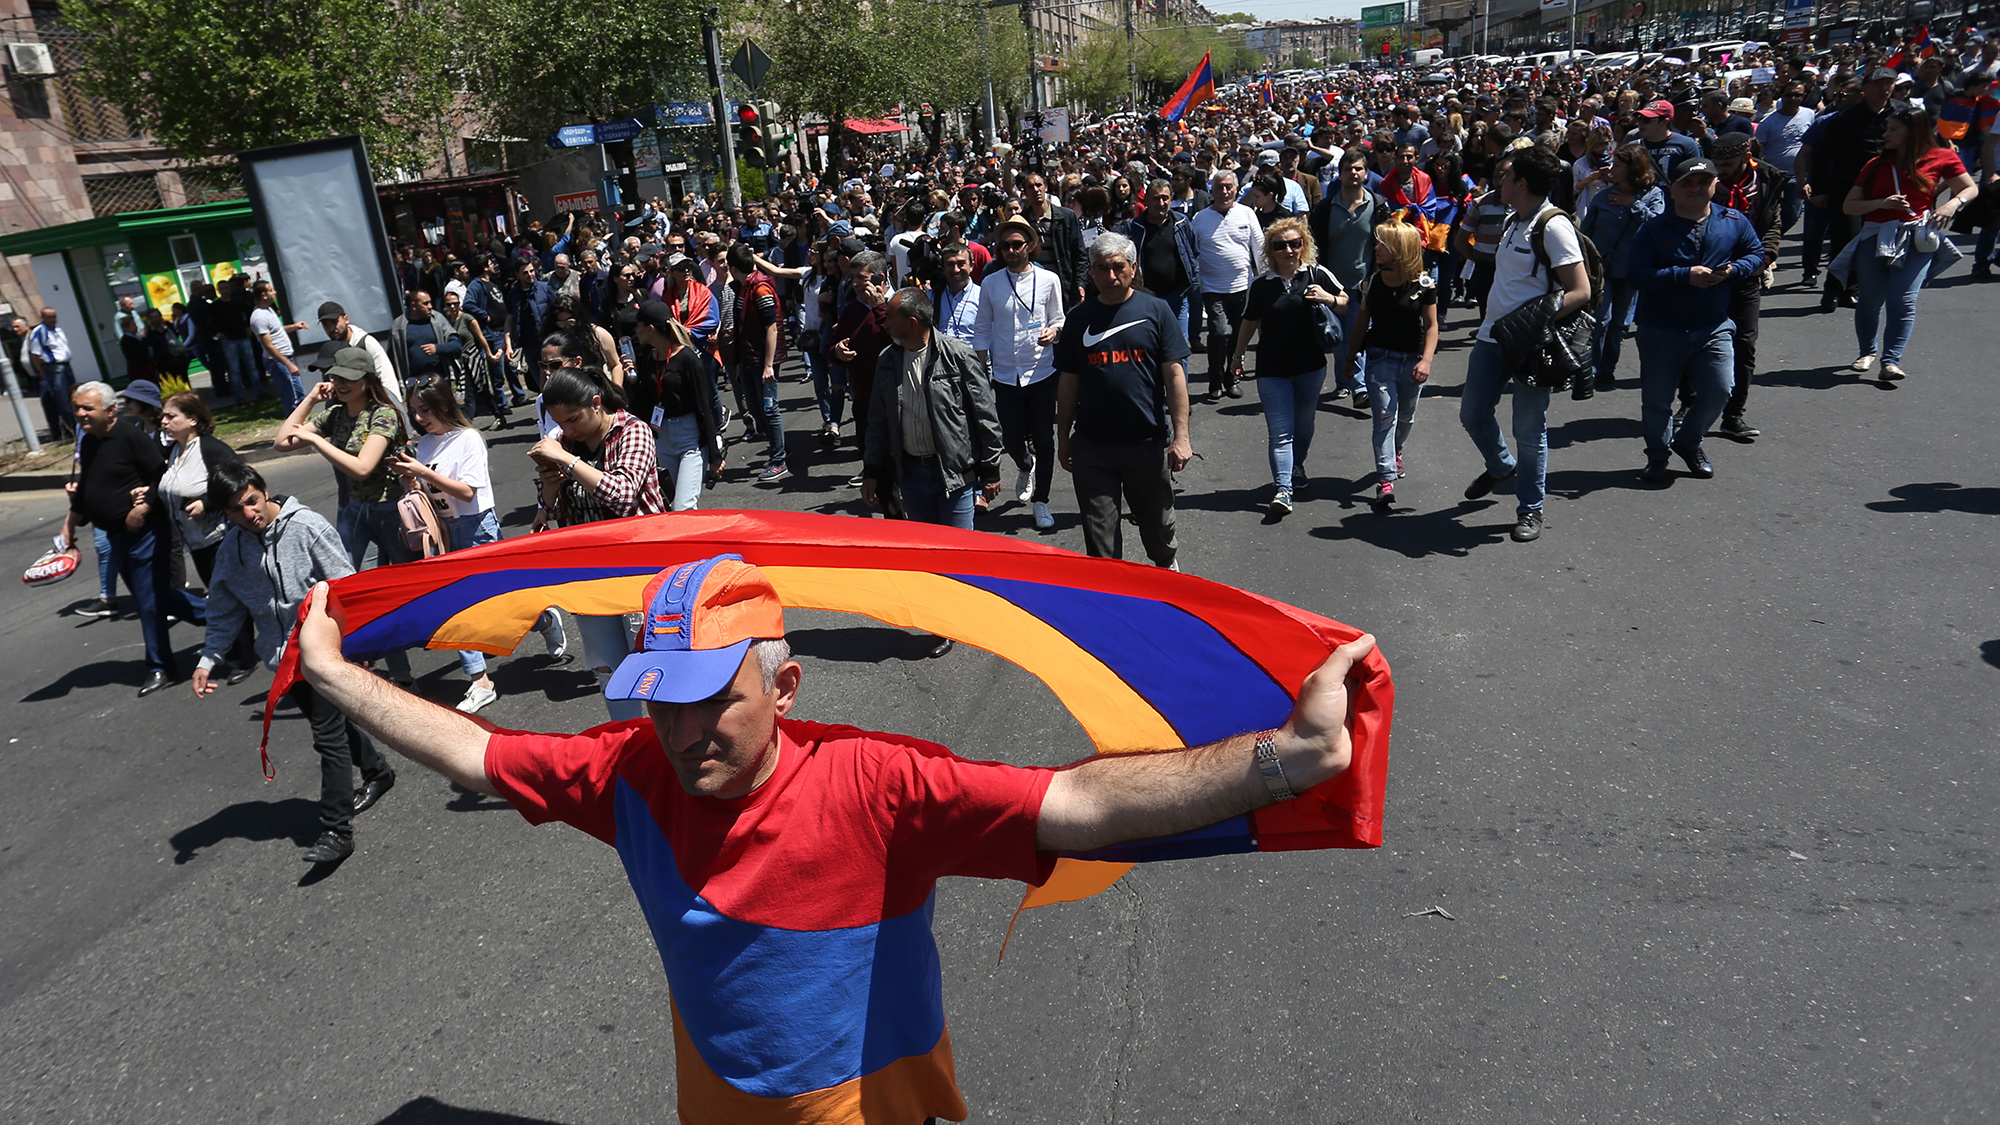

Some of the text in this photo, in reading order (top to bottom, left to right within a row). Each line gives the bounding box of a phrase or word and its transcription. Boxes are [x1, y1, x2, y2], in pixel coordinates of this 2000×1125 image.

[565, 136, 588, 144] KOMITAS
[557, 195, 599, 213] ՇԻՆԱՆՅՈ
[1087, 351, 1109, 365] JUST
[1112, 350, 1129, 363] DO
[636, 672, 659, 696] ARM
